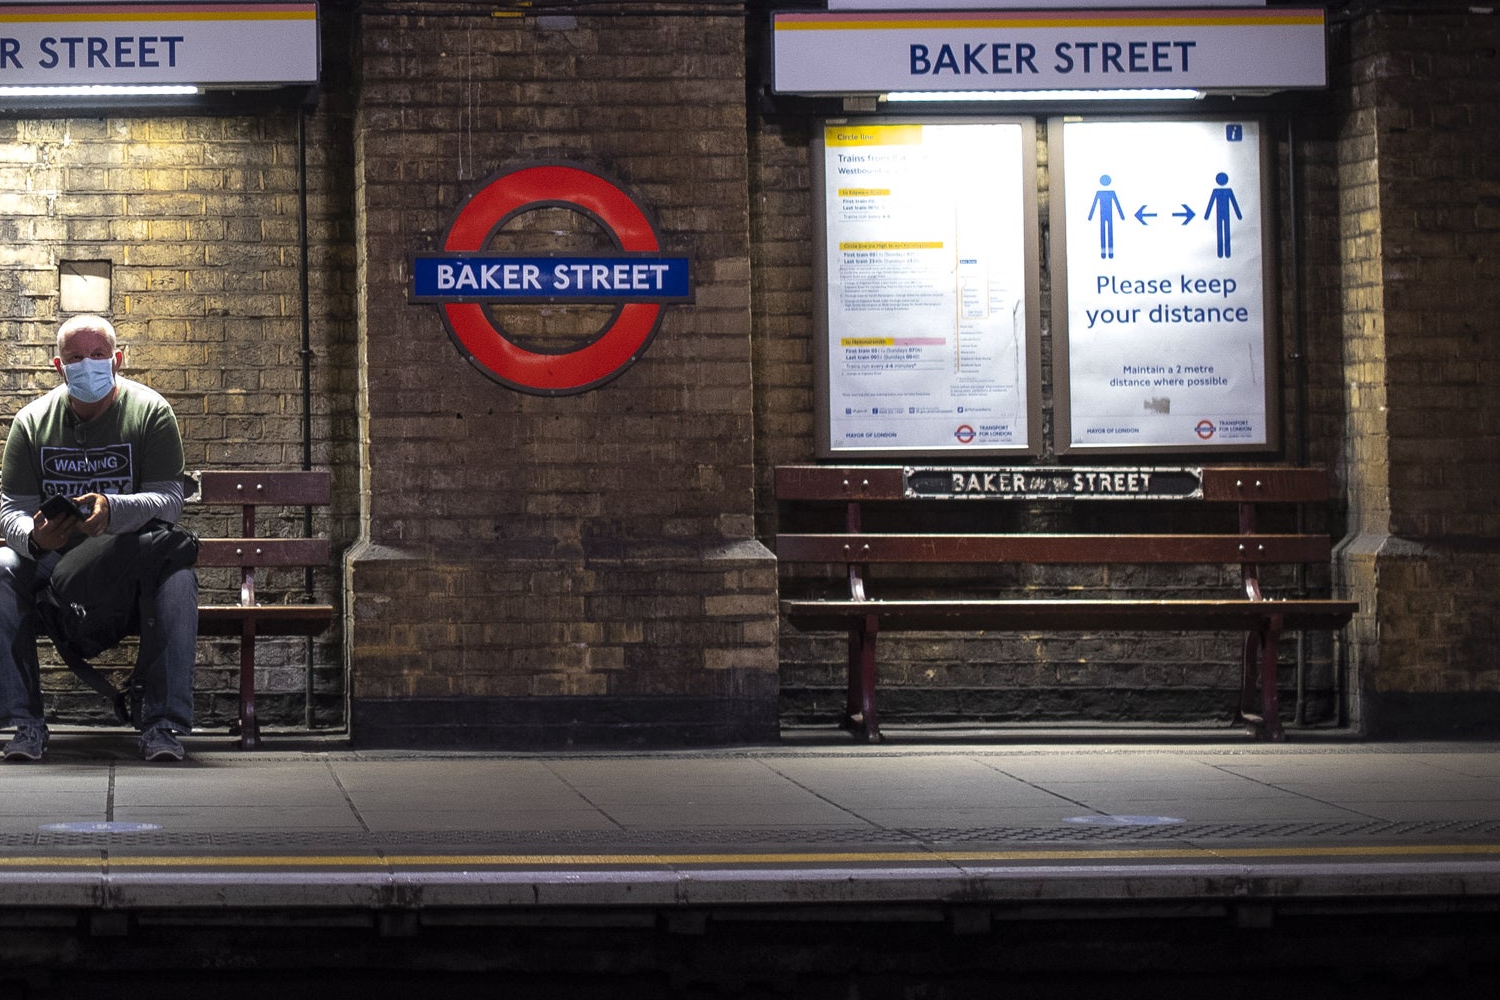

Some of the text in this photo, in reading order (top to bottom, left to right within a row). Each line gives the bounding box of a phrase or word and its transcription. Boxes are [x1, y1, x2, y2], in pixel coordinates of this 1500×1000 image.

[38, 35, 184, 69] STREET
[909, 40, 1196, 76] BAKER STREET
[837, 133, 874, 141] Circle line
[838, 153, 865, 163] Trains
[437, 264, 669, 290] BAKER STREET
[1097, 274, 1237, 298] Please keep
[1086, 303, 1249, 329] your distance
[1123, 365, 1165, 375] Maintain
[1176, 365, 1182, 374] 2
[1184, 365, 1214, 374] metre
[1109, 376, 1228, 388] distance where possible
[54, 456, 118, 472] WARNING
[951, 473, 1027, 492] BAKER
[1072, 473, 1151, 491] STREET
